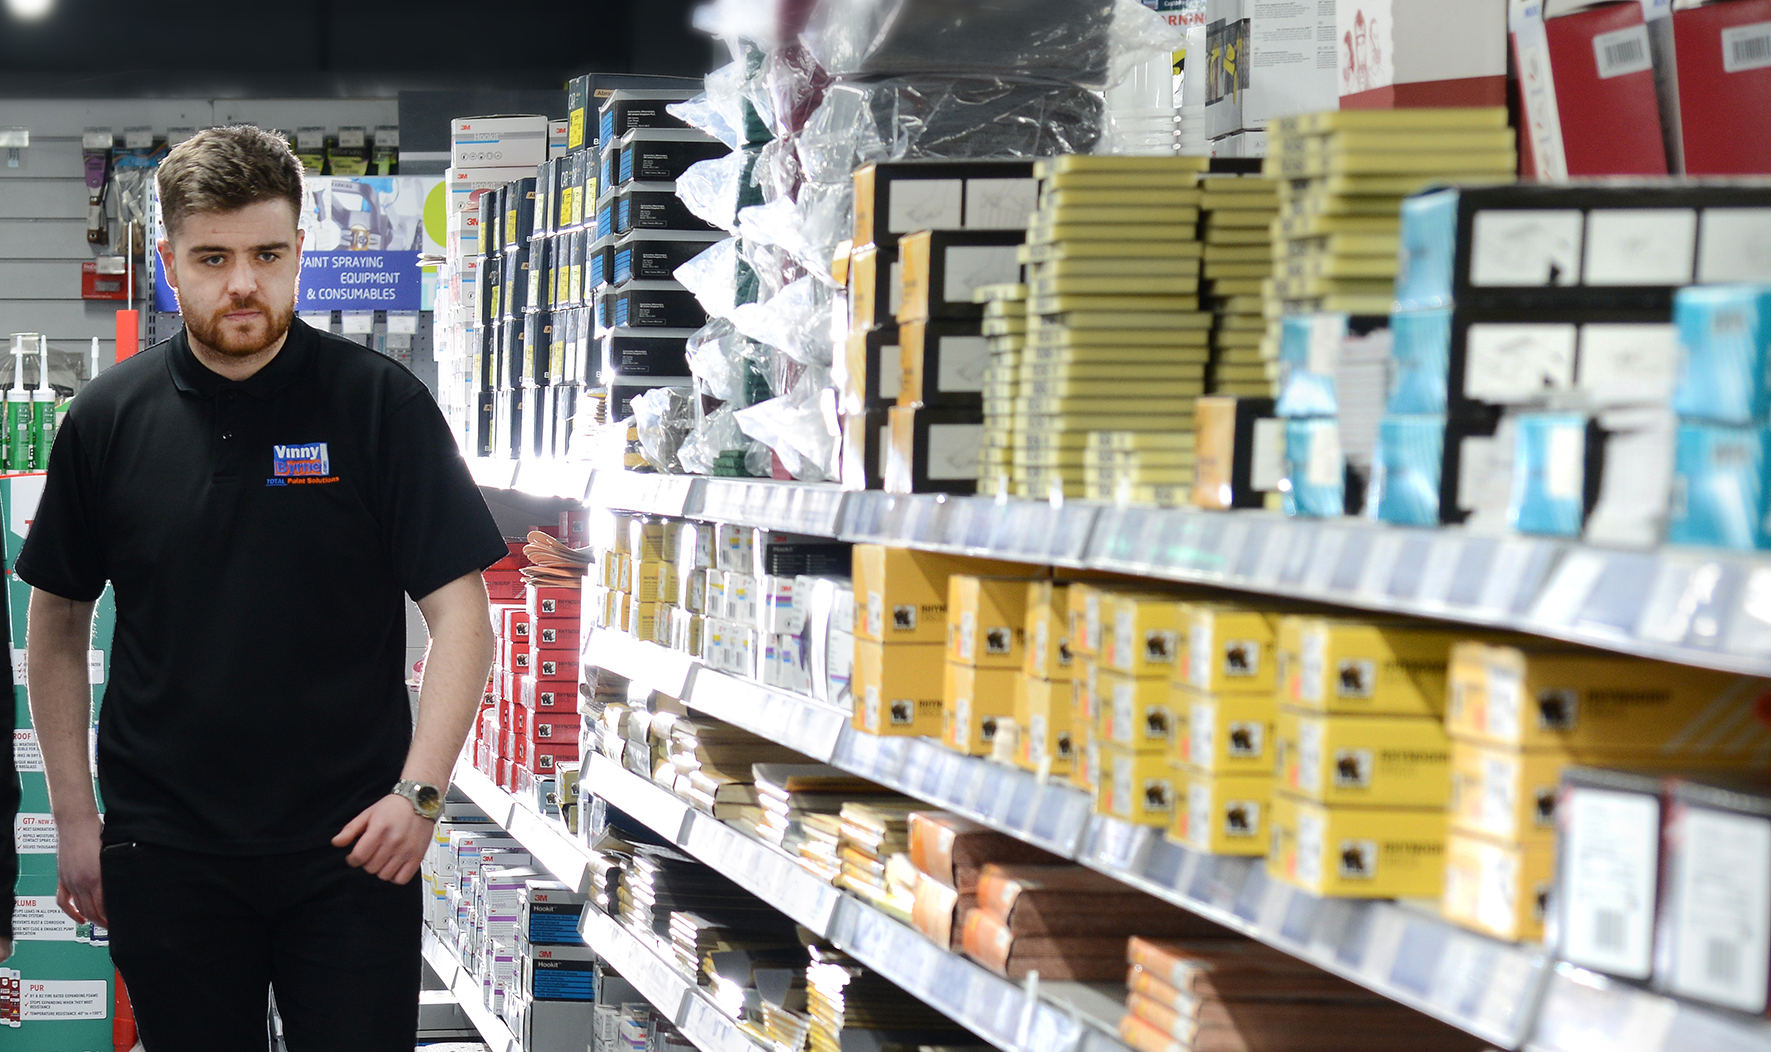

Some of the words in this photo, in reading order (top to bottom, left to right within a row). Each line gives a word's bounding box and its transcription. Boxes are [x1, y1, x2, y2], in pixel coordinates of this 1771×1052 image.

[332, 256, 384, 268] SPRAYING
[340, 272, 401, 285] EQUIPMENT
[306, 288, 316, 300] &
[318, 288, 396, 300] CONSUMABLES
[274, 445, 319, 460] Vinny
[277, 461, 321, 475] Byrne
[23, 817, 35, 825] GT7
